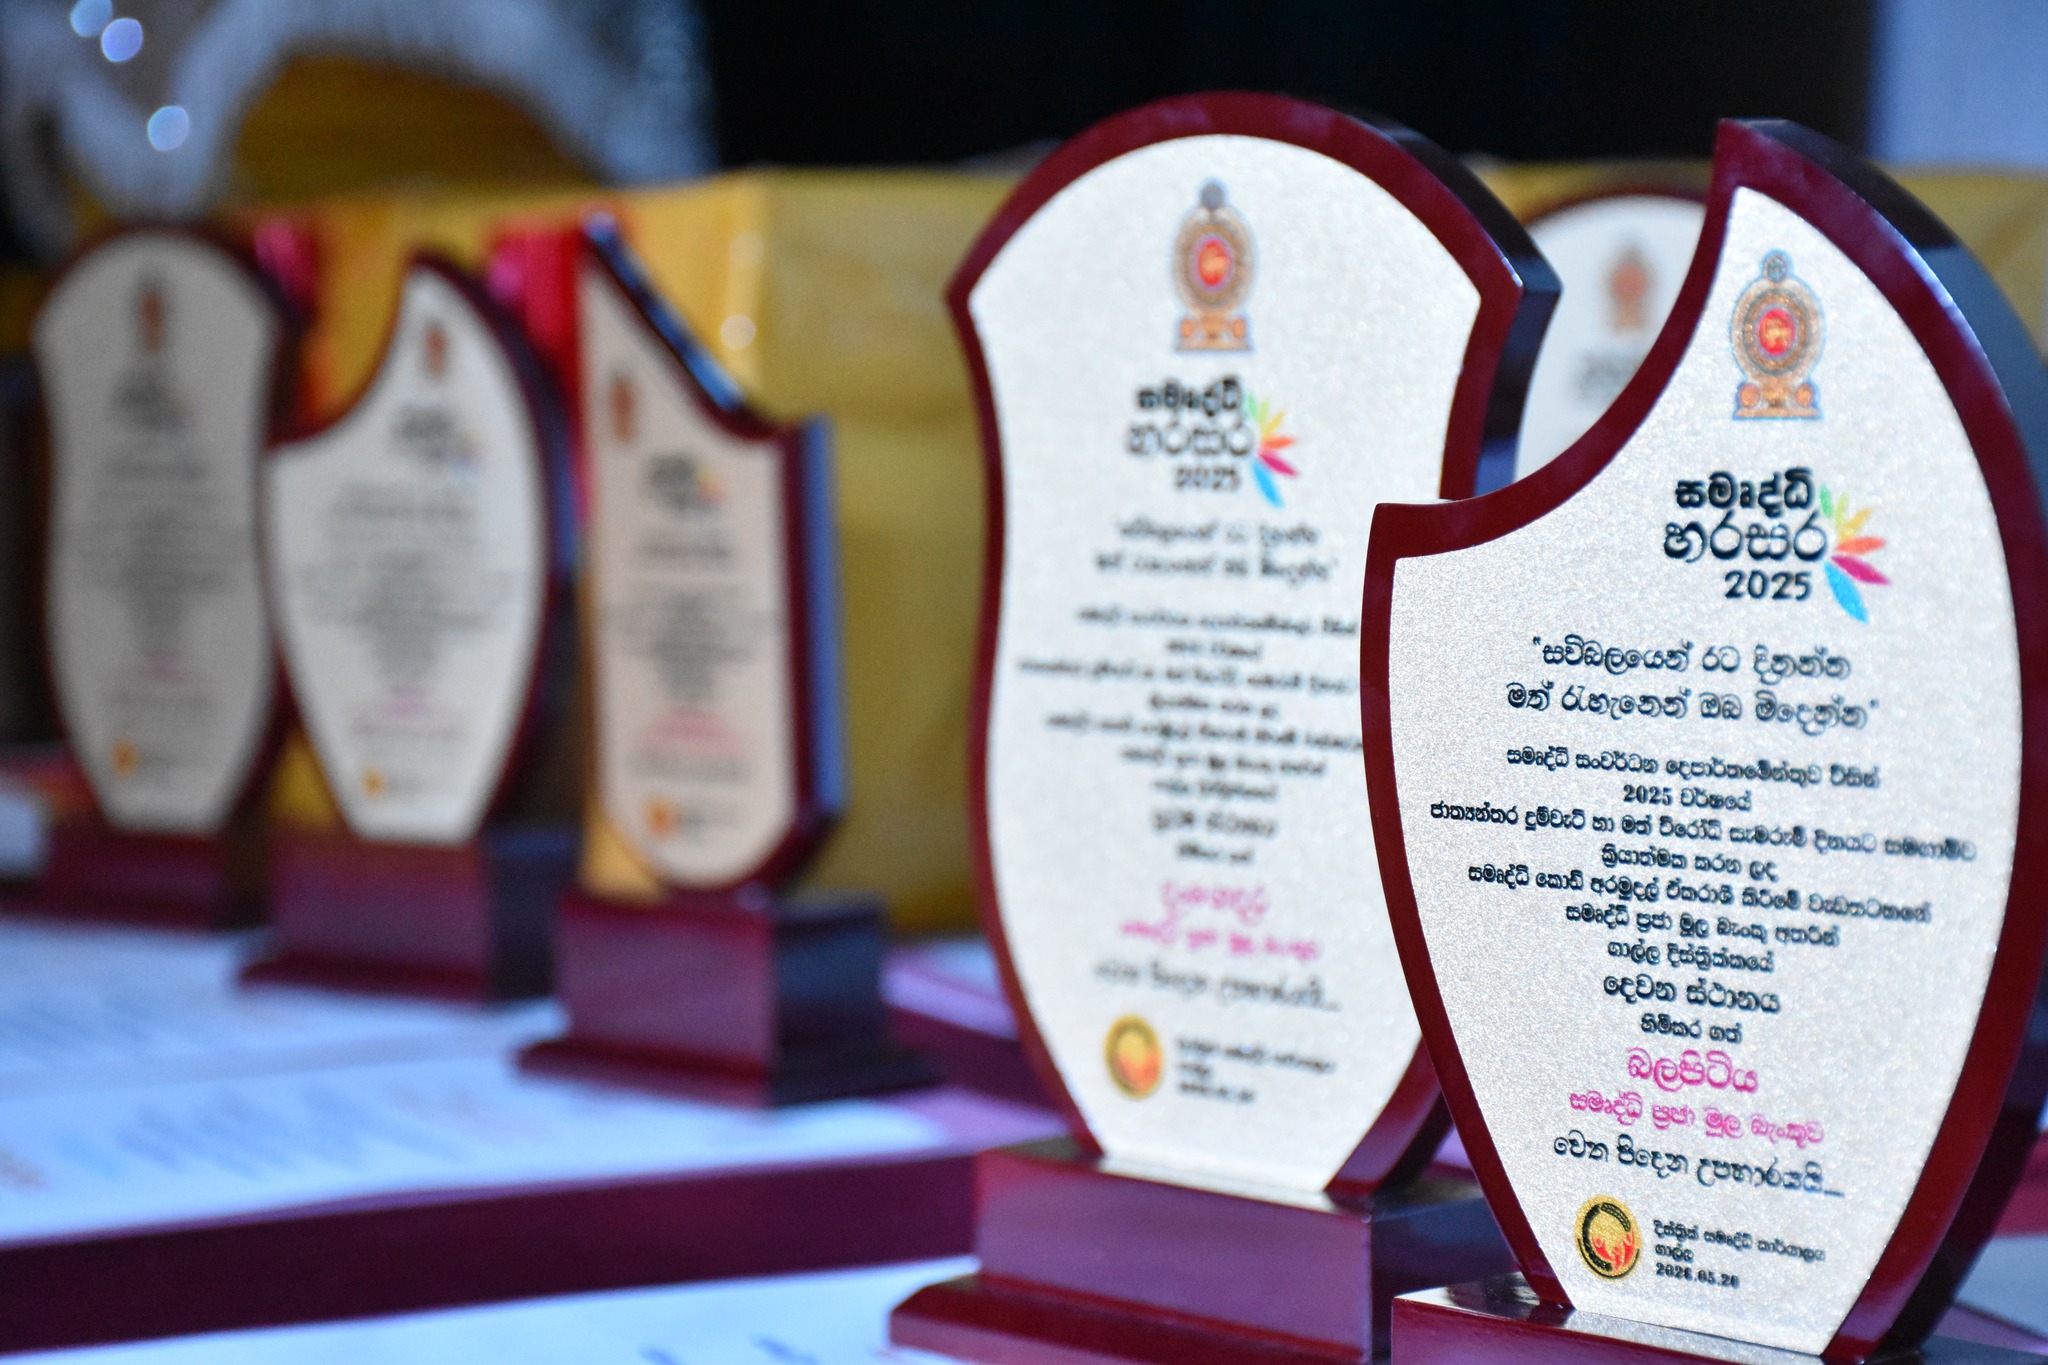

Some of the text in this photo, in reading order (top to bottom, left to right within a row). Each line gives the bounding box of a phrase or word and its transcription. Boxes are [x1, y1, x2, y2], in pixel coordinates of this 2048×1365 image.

[1725, 569, 1812, 601] 2025
[1702, 645, 1741, 673] රට
[1506, 679, 1554, 711] මත්
[1700, 691, 1742, 720] ඔබ
[1623, 784, 1673, 805] 2025
[1592, 815, 1615, 832] හා
[1621, 813, 1652, 836] මත්
[1603, 974, 1677, 1004] දෙවන
[1709, 1022, 1742, 1044] ගත්
[1553, 1129, 1609, 1162] වෙත
